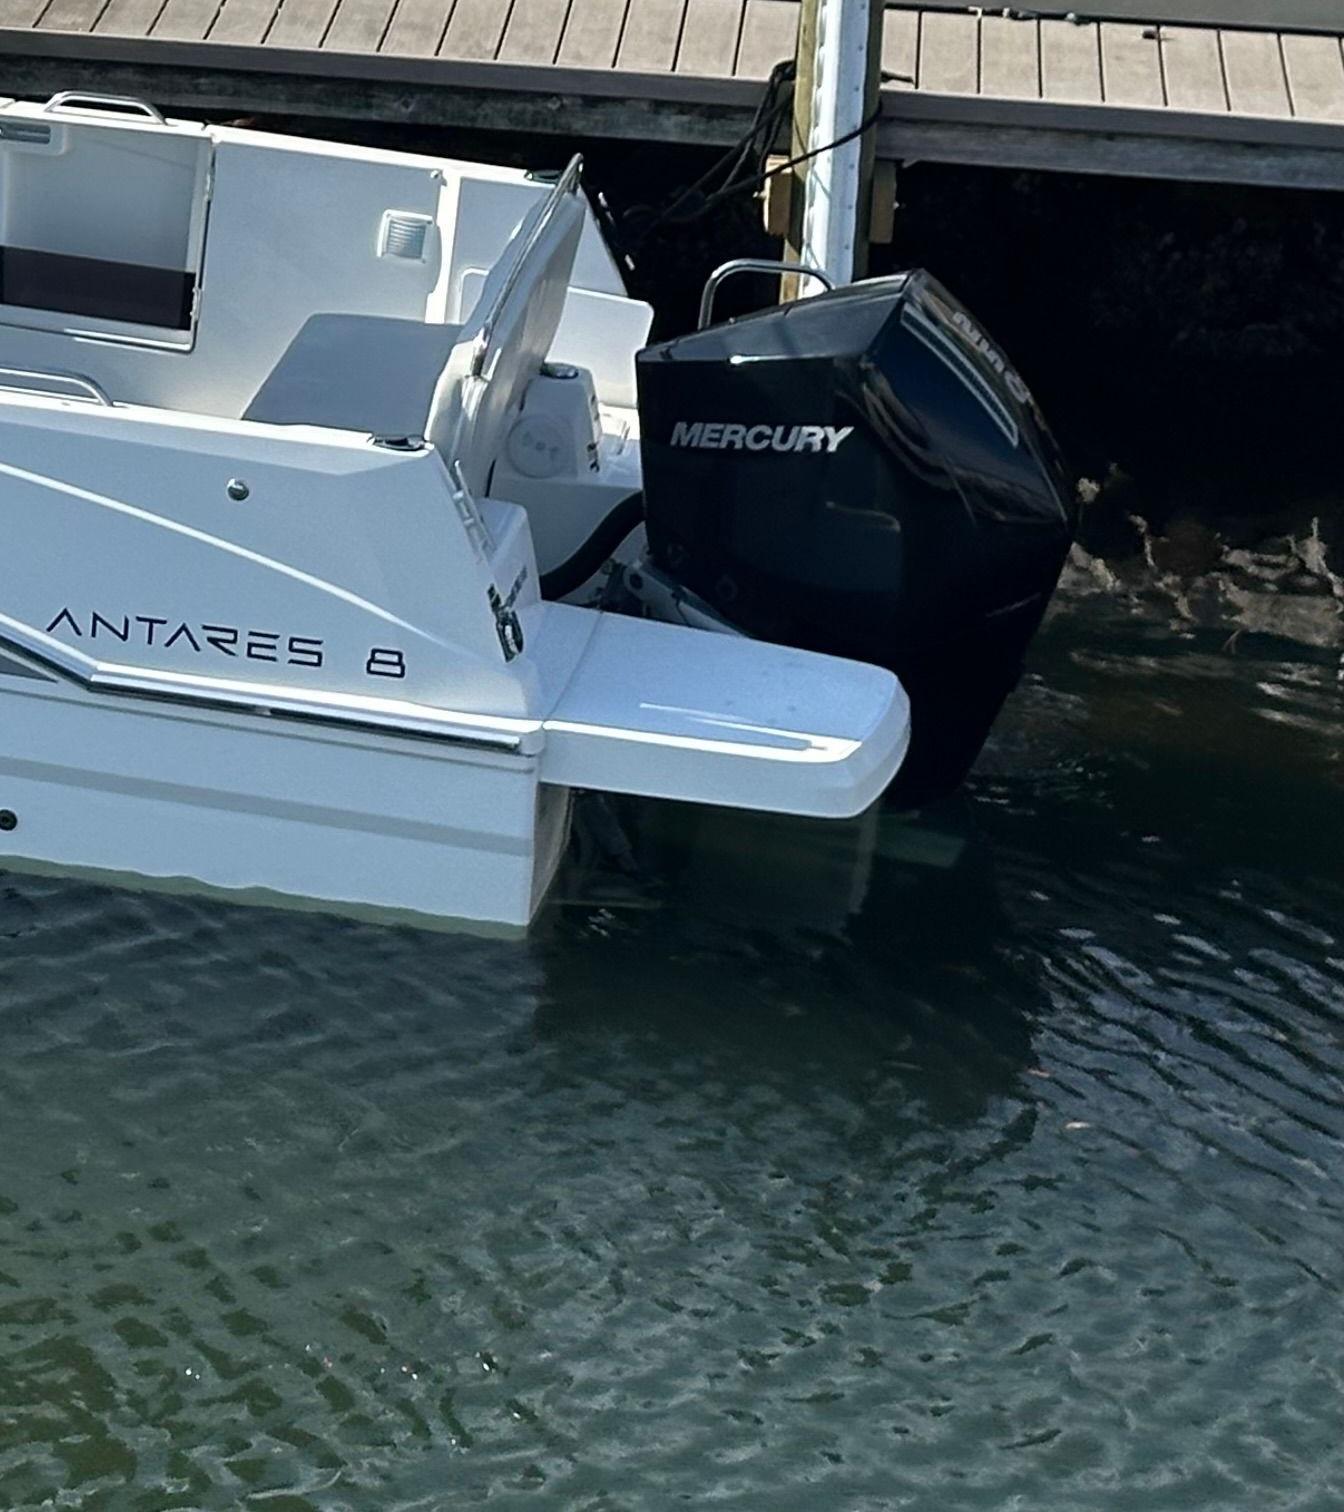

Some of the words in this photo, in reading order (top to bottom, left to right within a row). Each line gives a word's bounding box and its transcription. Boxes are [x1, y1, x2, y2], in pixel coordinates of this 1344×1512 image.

[670, 421, 854, 453] MERCURY
[46, 607, 324, 668] ANTARES
[366, 647, 406, 679] 8
